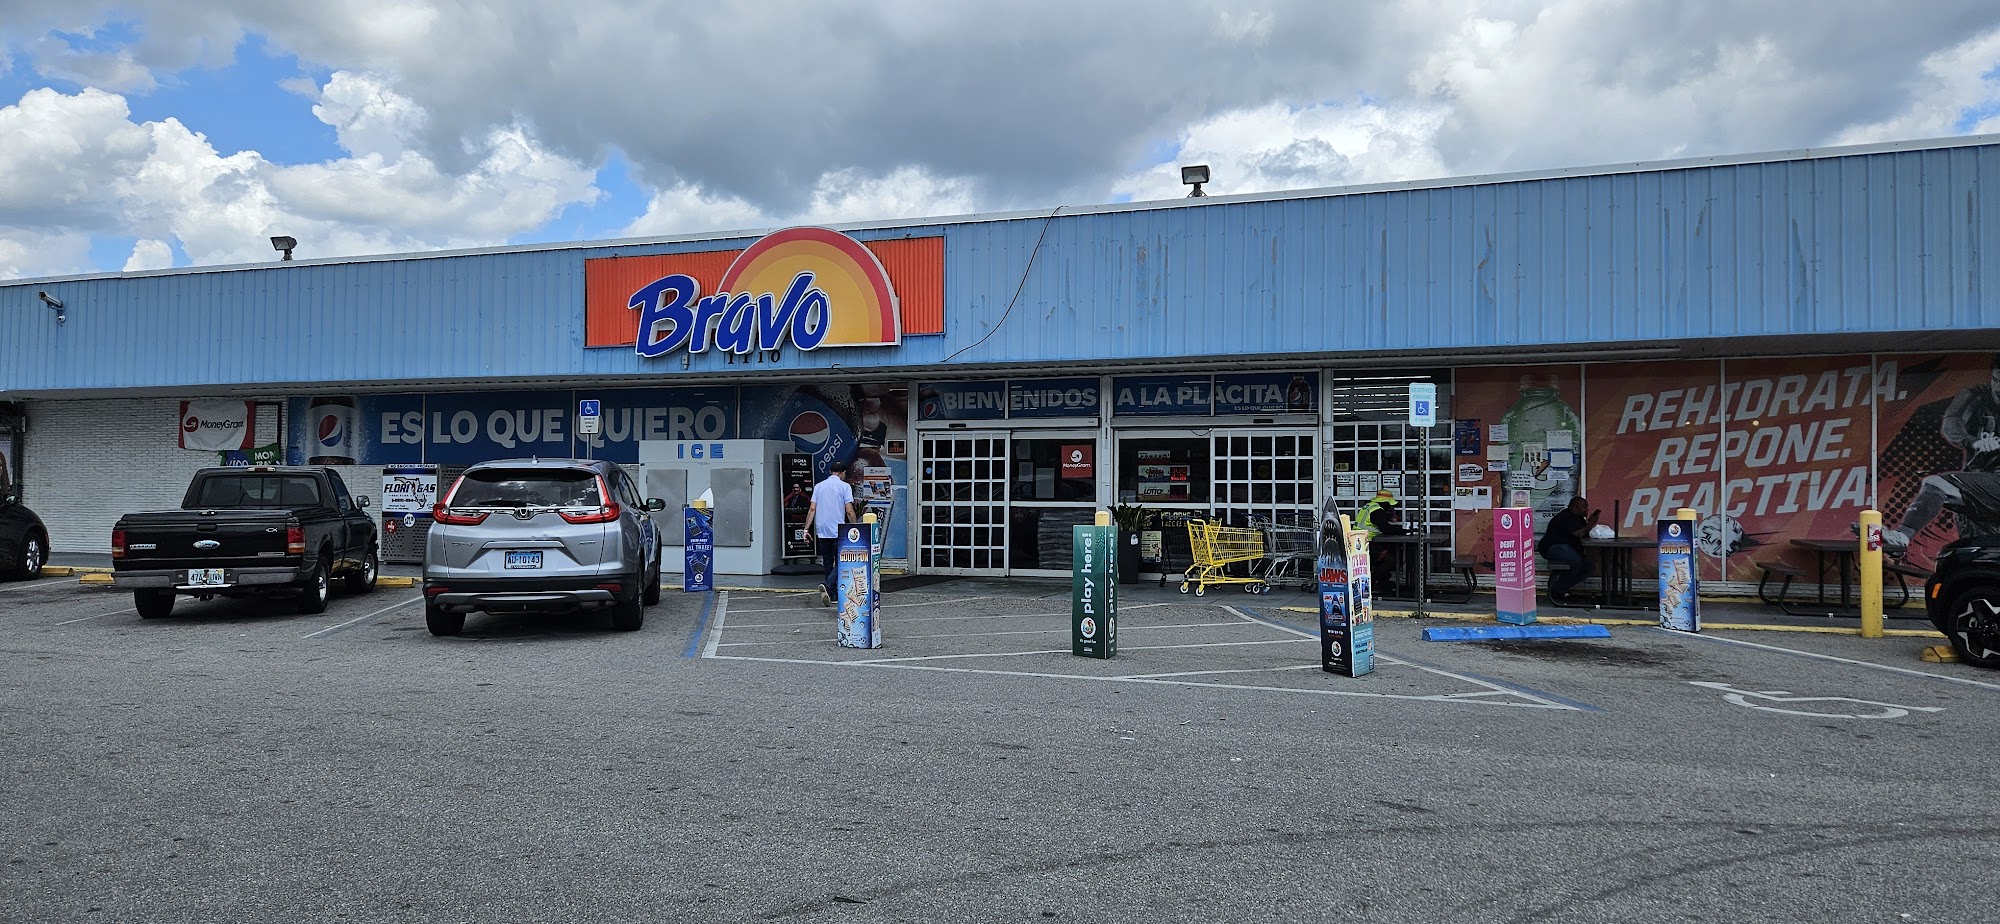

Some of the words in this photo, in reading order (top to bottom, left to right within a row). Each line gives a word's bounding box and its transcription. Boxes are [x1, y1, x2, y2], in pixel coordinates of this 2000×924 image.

[627, 270, 831, 358] Bravo
[728, 351, 781, 365] 1110
[944, 388, 1097, 410] BIENVENIDOS
[1117, 387, 1135, 406] A
[1140, 386, 1172, 406] LA
[1177, 384, 1284, 406] PLACITA
[1616, 361, 1908, 435] REHIDRATA.
[381, 410, 423, 444] ES
[432, 410, 479, 444] LO
[486, 409, 564, 449] QUE
[678, 443, 724, 459] ICE
[817, 433, 844, 473] pepsi
[1649, 417, 1853, 478] REPONE.
[416, 483, 436, 493] GAS
[1623, 465, 1872, 529] REACTIVA.
[1081, 532, 1092, 573] here!
[1499, 550, 1517, 559] CARDS
[1500, 540, 1515, 549] DEBIT
[1660, 546, 1677, 555] GOOD
[1678, 546, 1691, 555] FUN
[839, 553, 856, 562] GOOD
[856, 553, 869, 562] FUN
[1320, 567, 1348, 585] JAWS
[1081, 577, 1094, 614] play
